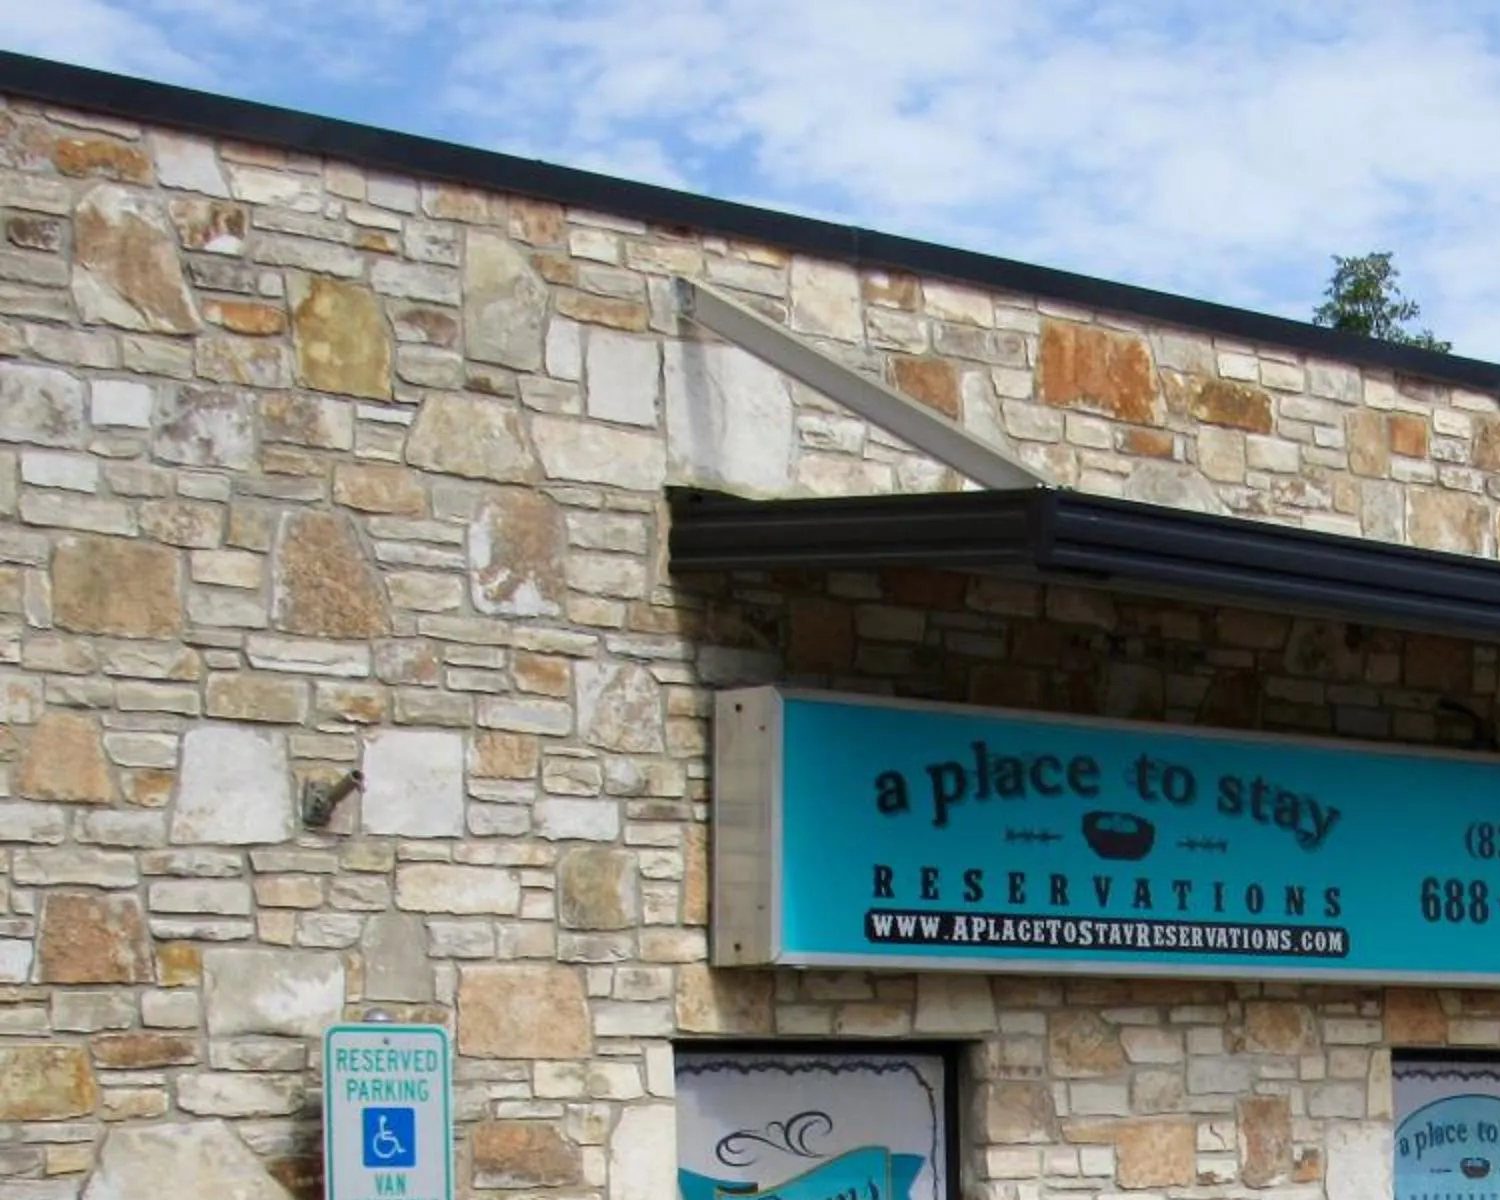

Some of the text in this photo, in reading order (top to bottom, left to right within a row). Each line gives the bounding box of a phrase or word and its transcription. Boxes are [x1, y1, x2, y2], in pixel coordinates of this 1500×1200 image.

[875, 740, 1342, 852] a place to stay
[872, 864, 1342, 918] RESERVATIONS
[336, 1048, 438, 1073] RESERVED
[346, 1079, 430, 1102] PARKING
[1414, 1120, 1469, 1160] place
[1477, 1120, 1499, 1144] to
[375, 1173, 407, 1196] VAN
